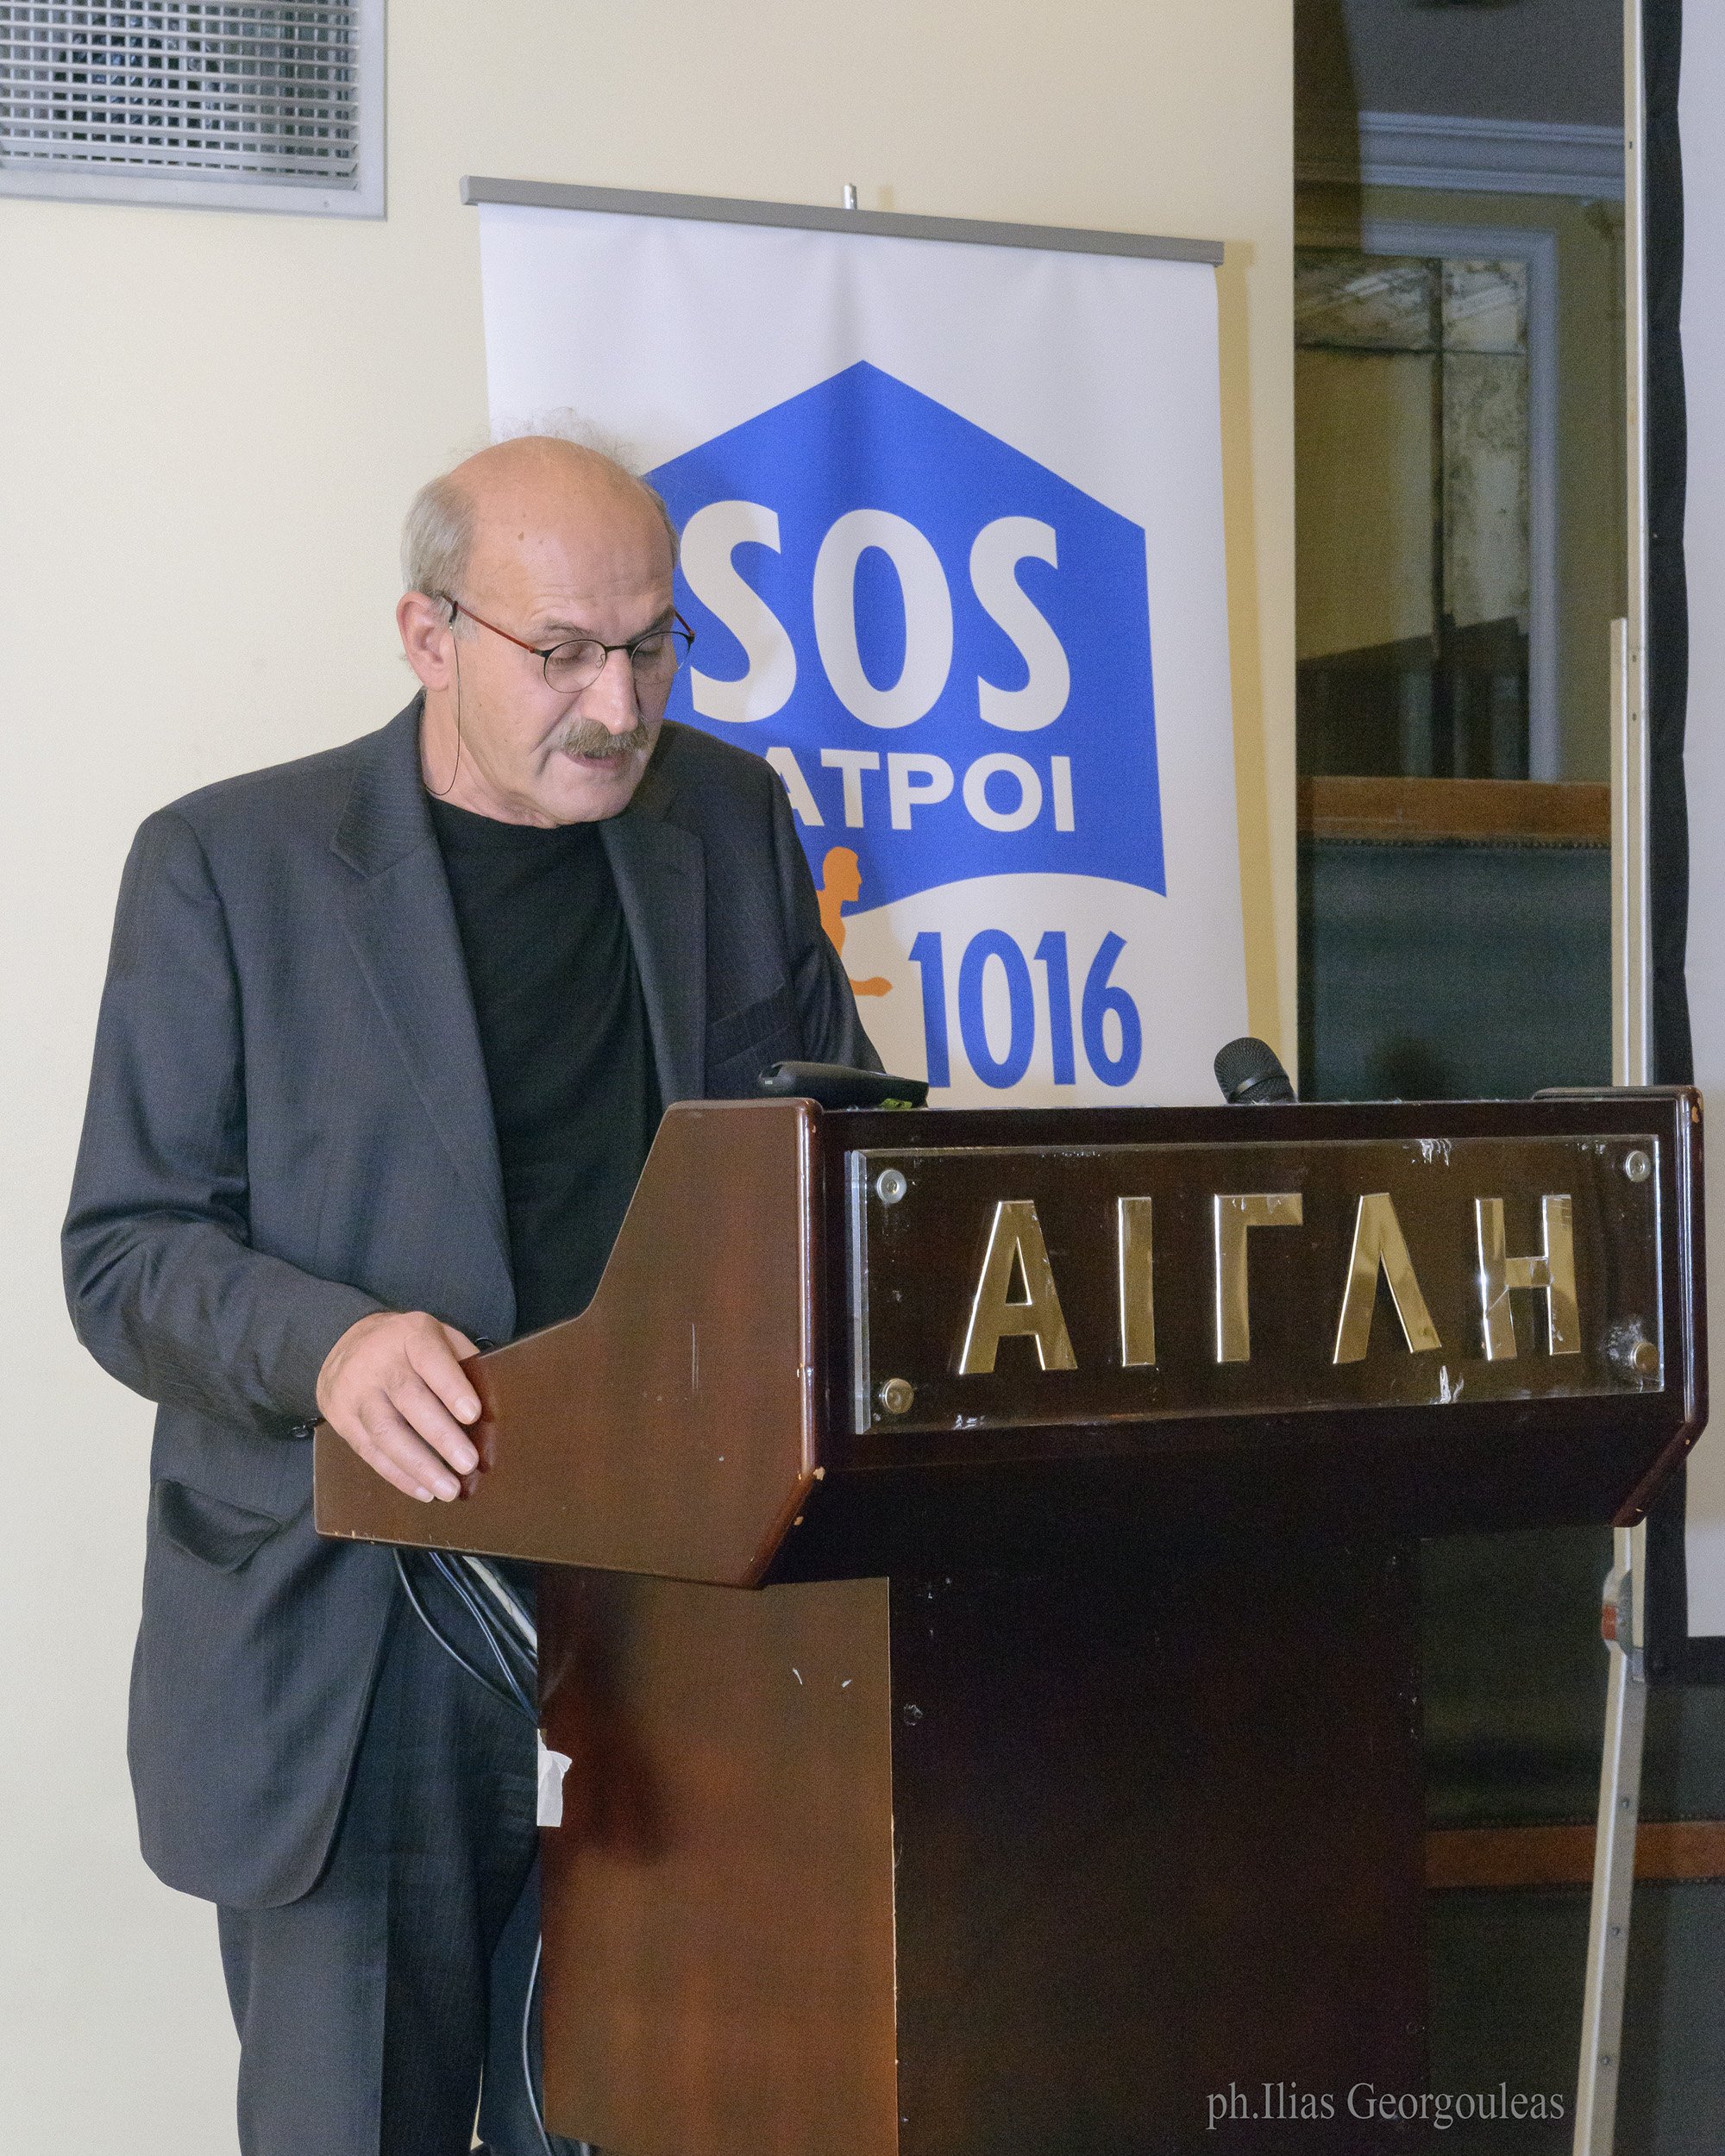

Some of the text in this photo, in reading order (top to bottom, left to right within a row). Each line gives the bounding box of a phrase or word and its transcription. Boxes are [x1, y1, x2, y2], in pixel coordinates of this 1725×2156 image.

[680, 499, 1071, 732] SOS
[765, 747, 1076, 832] ΑΤΡΟΙ
[908, 928, 1143, 1089] 1016
[958, 1192, 1582, 1376] ΑΙΓΛΗ
